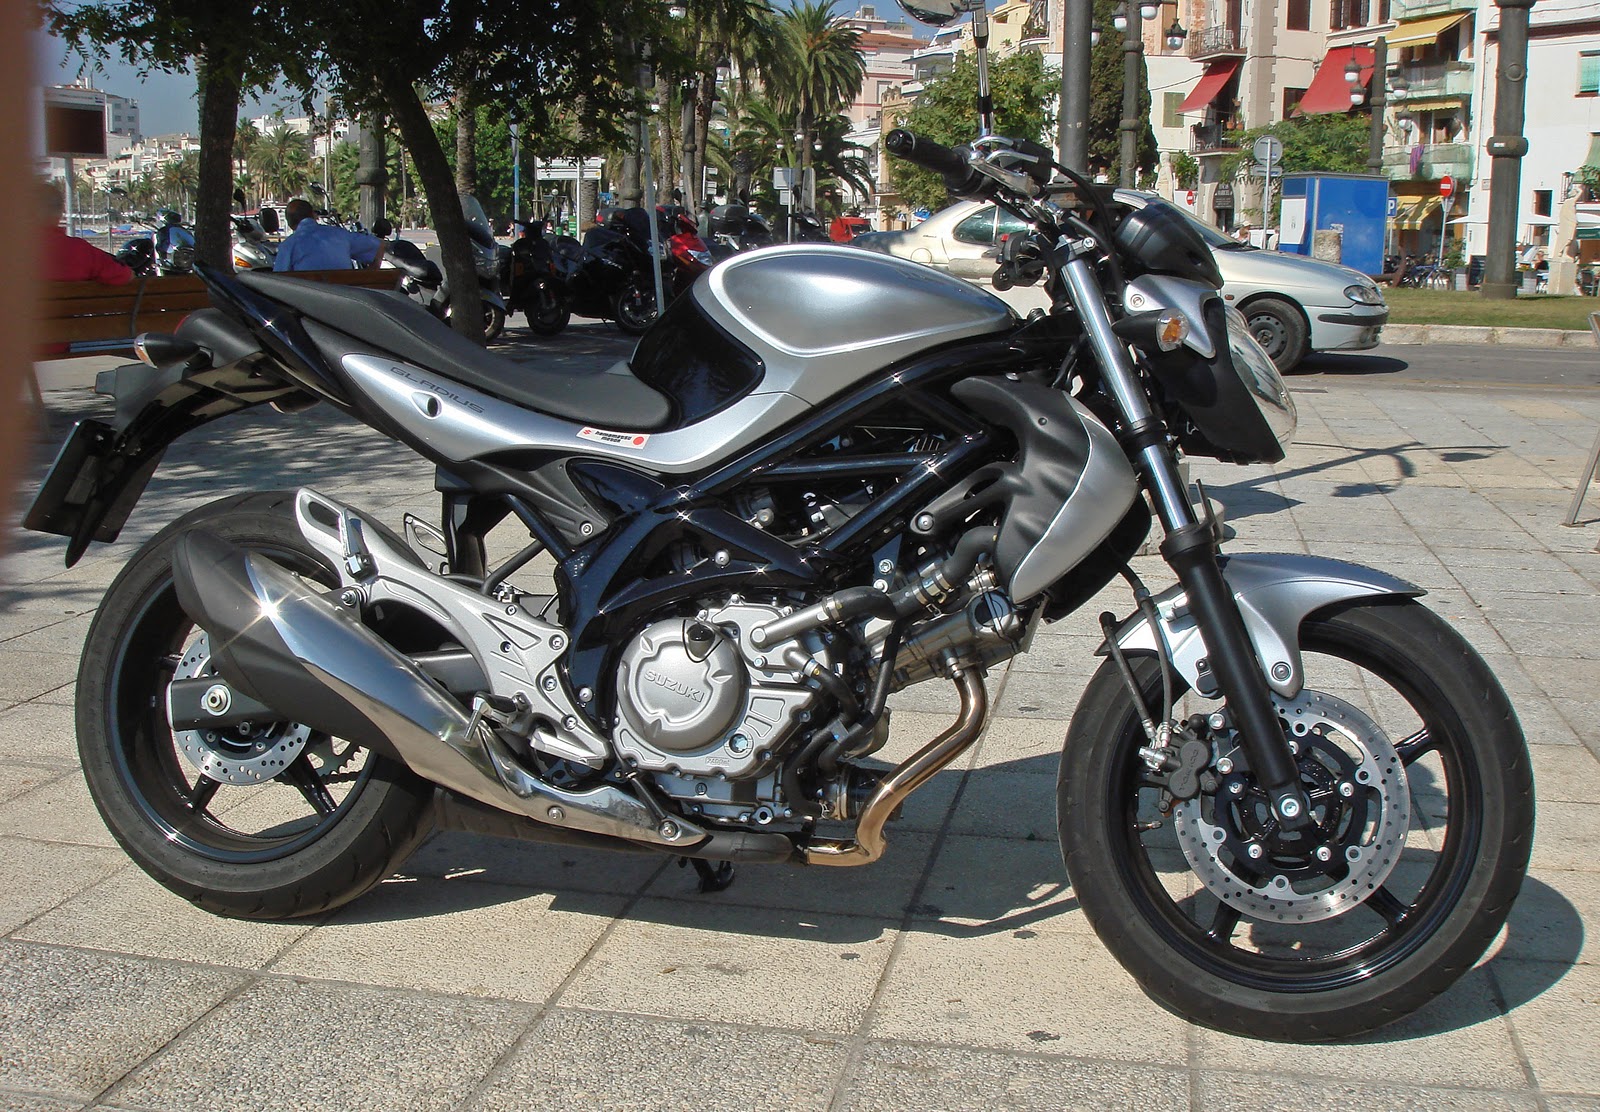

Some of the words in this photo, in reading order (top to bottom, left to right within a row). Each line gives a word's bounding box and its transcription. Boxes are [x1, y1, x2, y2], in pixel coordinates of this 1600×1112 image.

[1388, 199, 1395, 214] P
[390, 367, 485, 414] GLADIUS
[644, 671, 705, 703] SUZUKI
